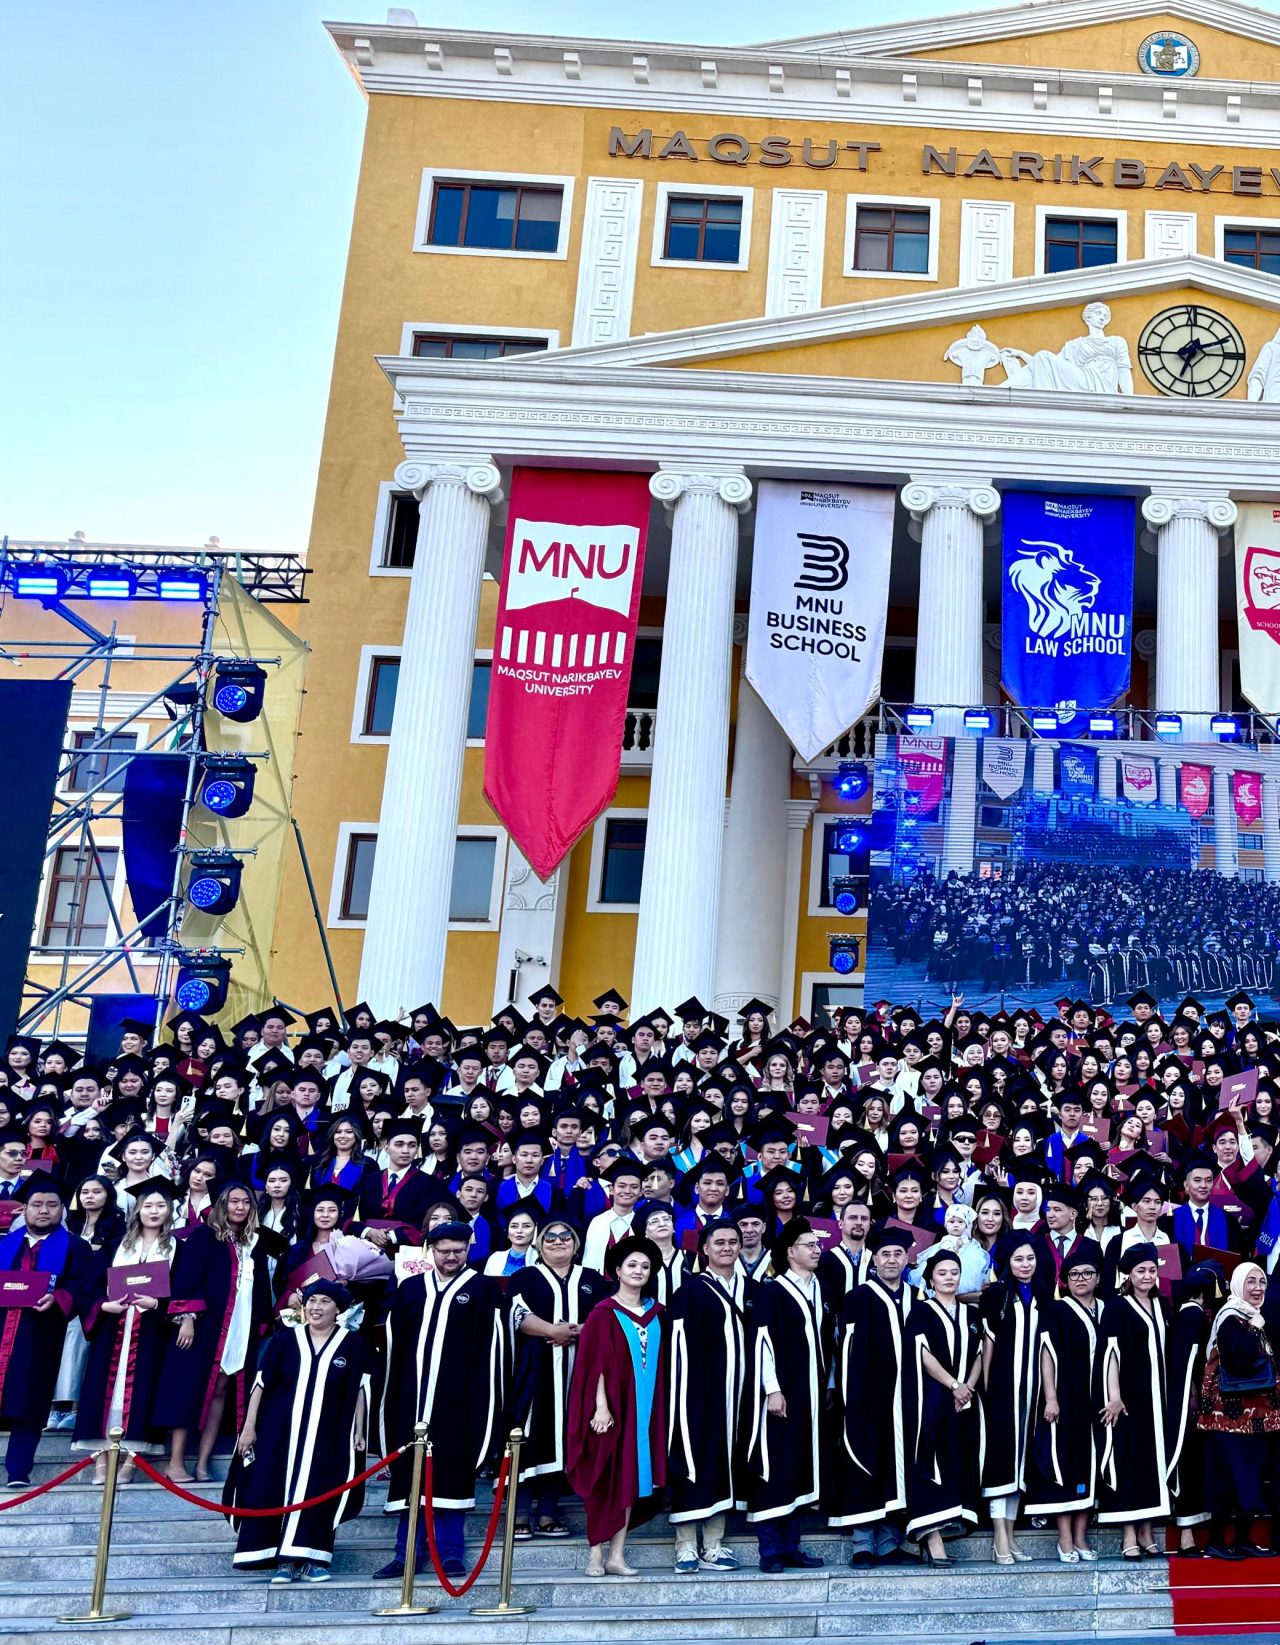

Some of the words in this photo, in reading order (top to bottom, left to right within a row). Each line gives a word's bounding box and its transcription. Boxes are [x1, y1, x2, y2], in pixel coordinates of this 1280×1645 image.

[608, 126, 881, 172] MAQSUT
[518, 539, 631, 579] MNU
[796, 594, 843, 615] MNU
[767, 611, 867, 642] BUSINESS
[1070, 612, 1125, 639] MNU
[770, 633, 860, 663] SCHOOL
[1026, 637, 1059, 657] LAW
[1063, 636, 1126, 657] SCHOOL
[497, 665, 550, 682] MAQSUT
[552, 669, 622, 684] NARIKBAYEV
[525, 683, 594, 696] UNIVERSITY
[902, 736, 942, 751] MNU
[1259, 1231, 1273, 1248] 2024
